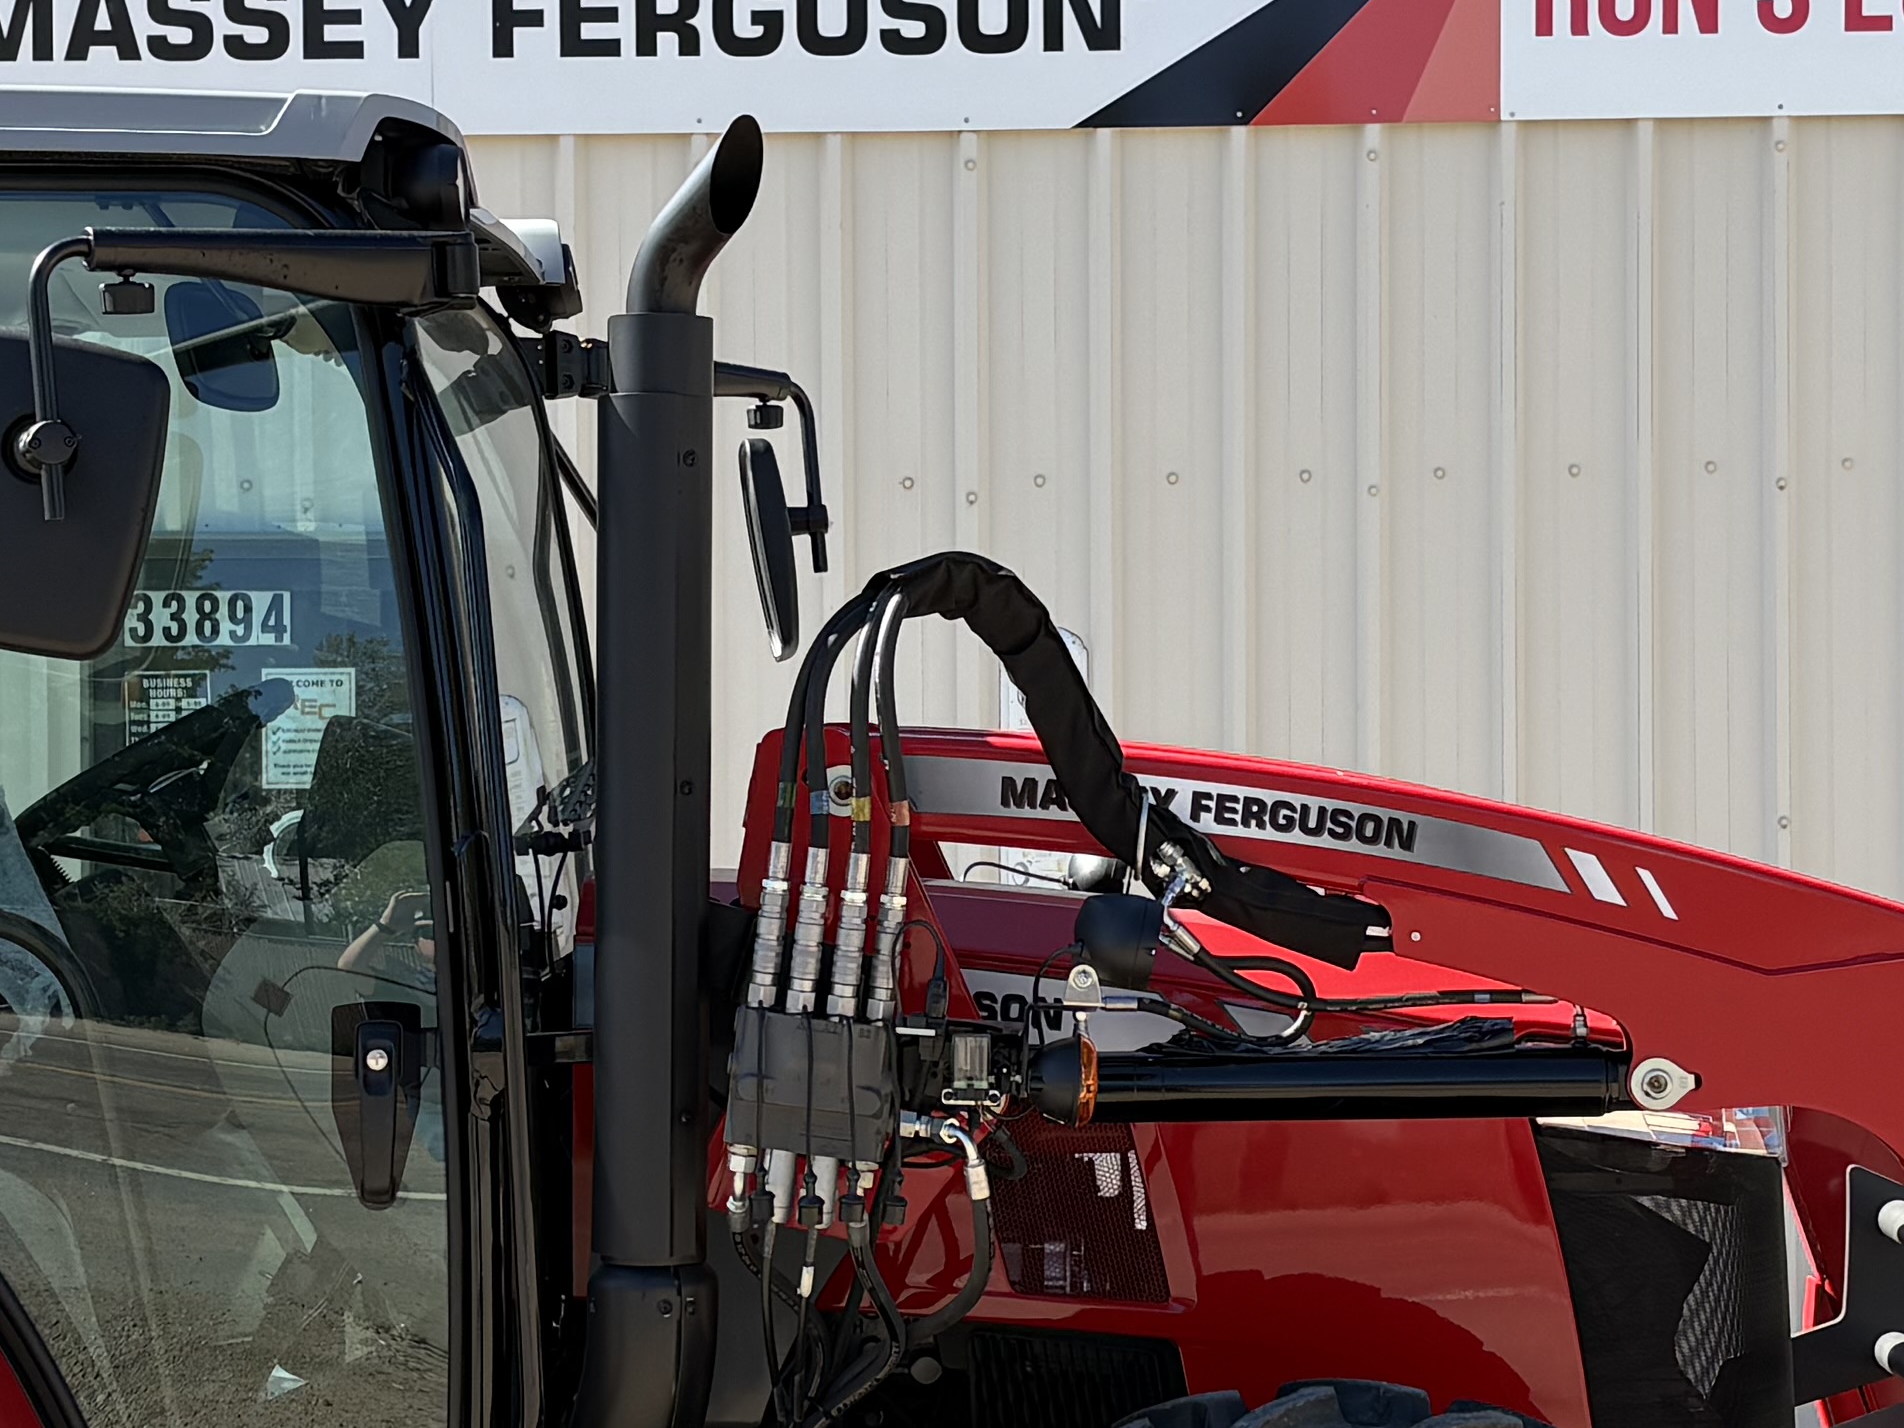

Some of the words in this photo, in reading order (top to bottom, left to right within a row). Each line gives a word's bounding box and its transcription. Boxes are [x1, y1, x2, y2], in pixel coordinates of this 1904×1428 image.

[127, 591, 288, 645] 33894
[142, 678, 193, 688] BUSINESS
[330, 679, 344, 688] TO
[999, 775, 1179, 814] MAY
[1189, 790, 1417, 853] FERGUSON
